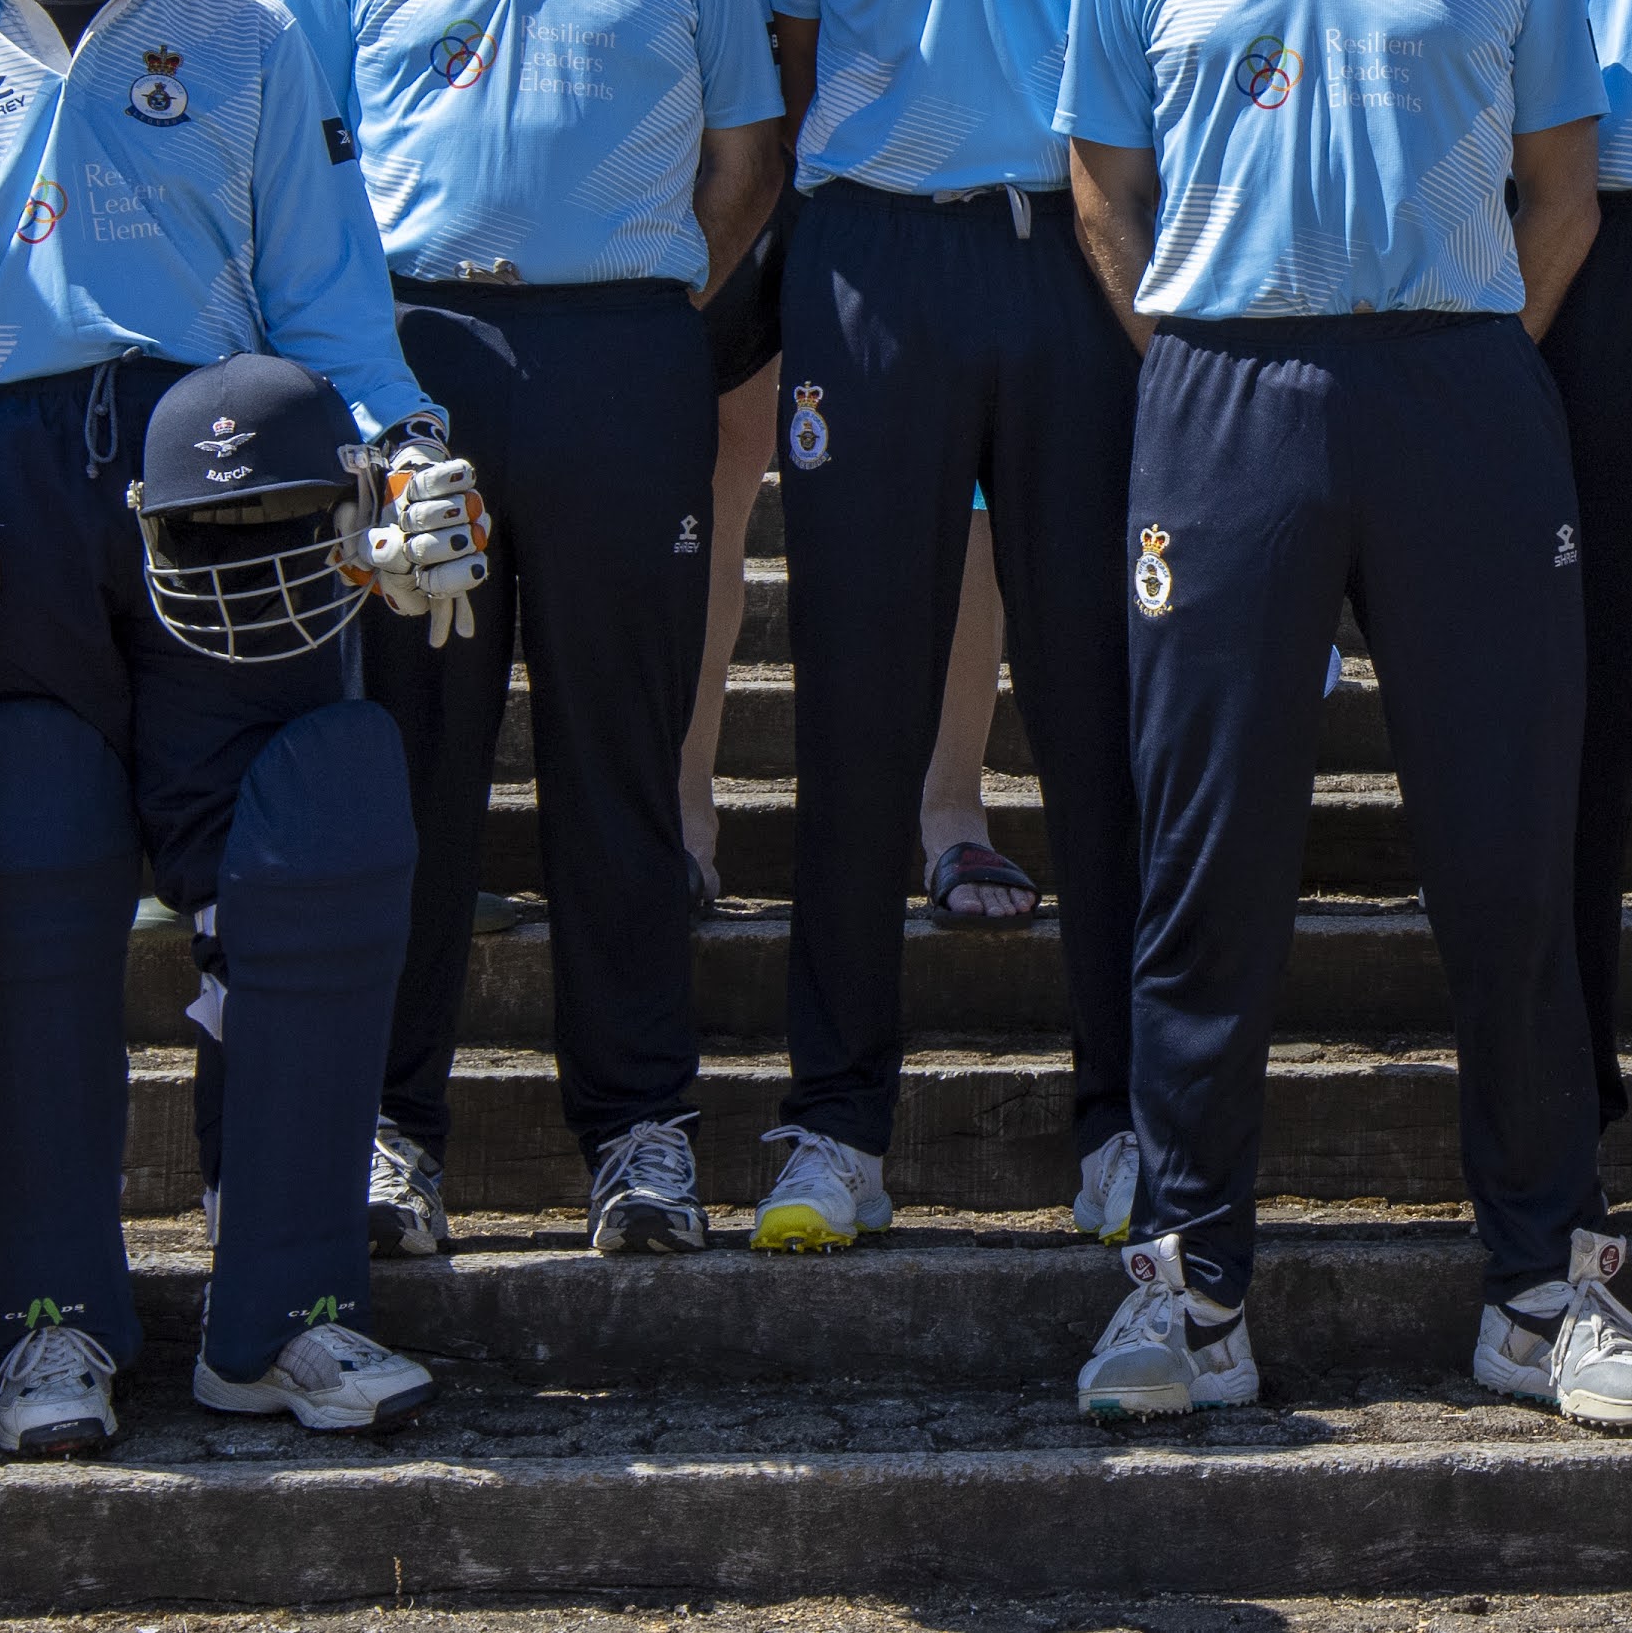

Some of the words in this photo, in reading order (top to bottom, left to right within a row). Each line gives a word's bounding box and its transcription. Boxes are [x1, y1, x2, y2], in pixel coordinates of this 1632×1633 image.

[521, 15, 616, 49] Resilient
[1325, 28, 1424, 58] Resilient
[521, 42, 603, 72] Leaders
[1327, 56, 1410, 81] Leaders
[519, 65, 614, 100] Elements
[1328, 83, 1422, 113] Elements
[206, 466, 253, 483] RAFCA
